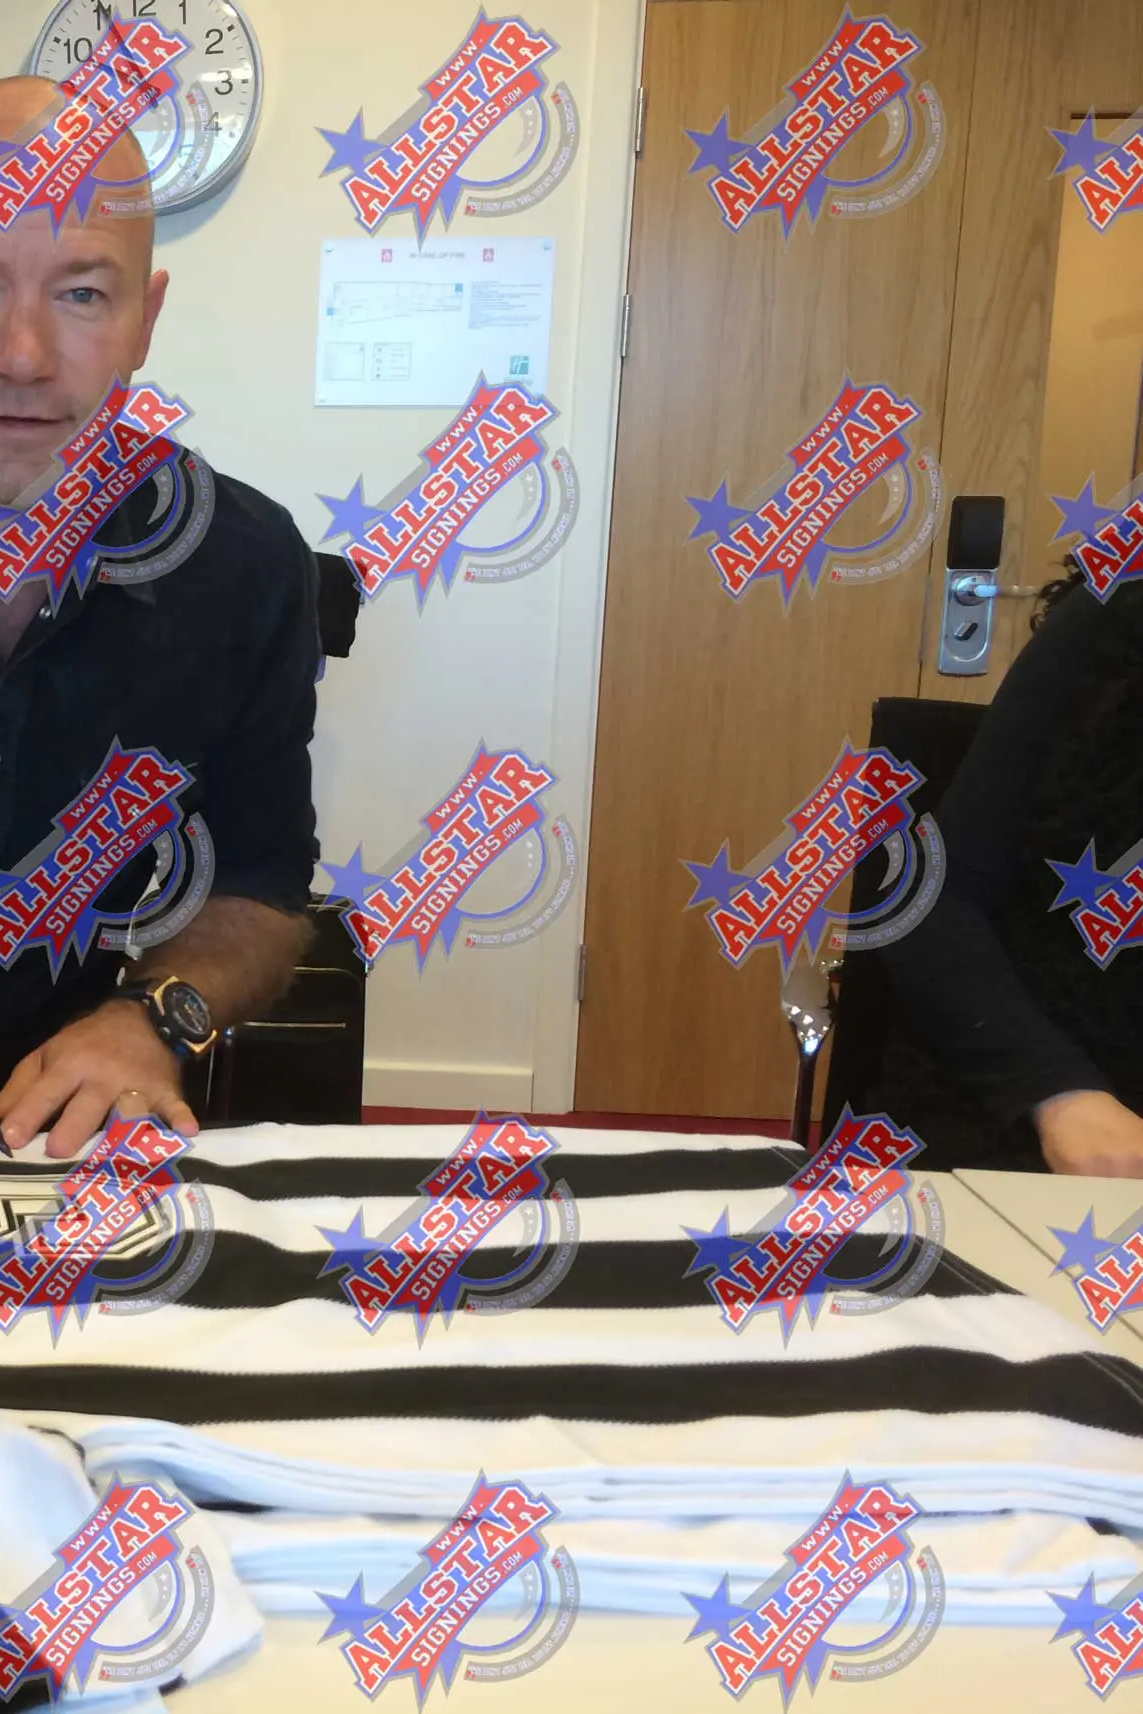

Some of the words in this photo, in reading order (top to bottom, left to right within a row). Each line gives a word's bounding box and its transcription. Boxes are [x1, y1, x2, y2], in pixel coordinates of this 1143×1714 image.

[178, 0, 187, 24] 1
[63, 37, 93, 64] 10
[205, 28, 224, 54] 2
[214, 70, 234, 95] 3
